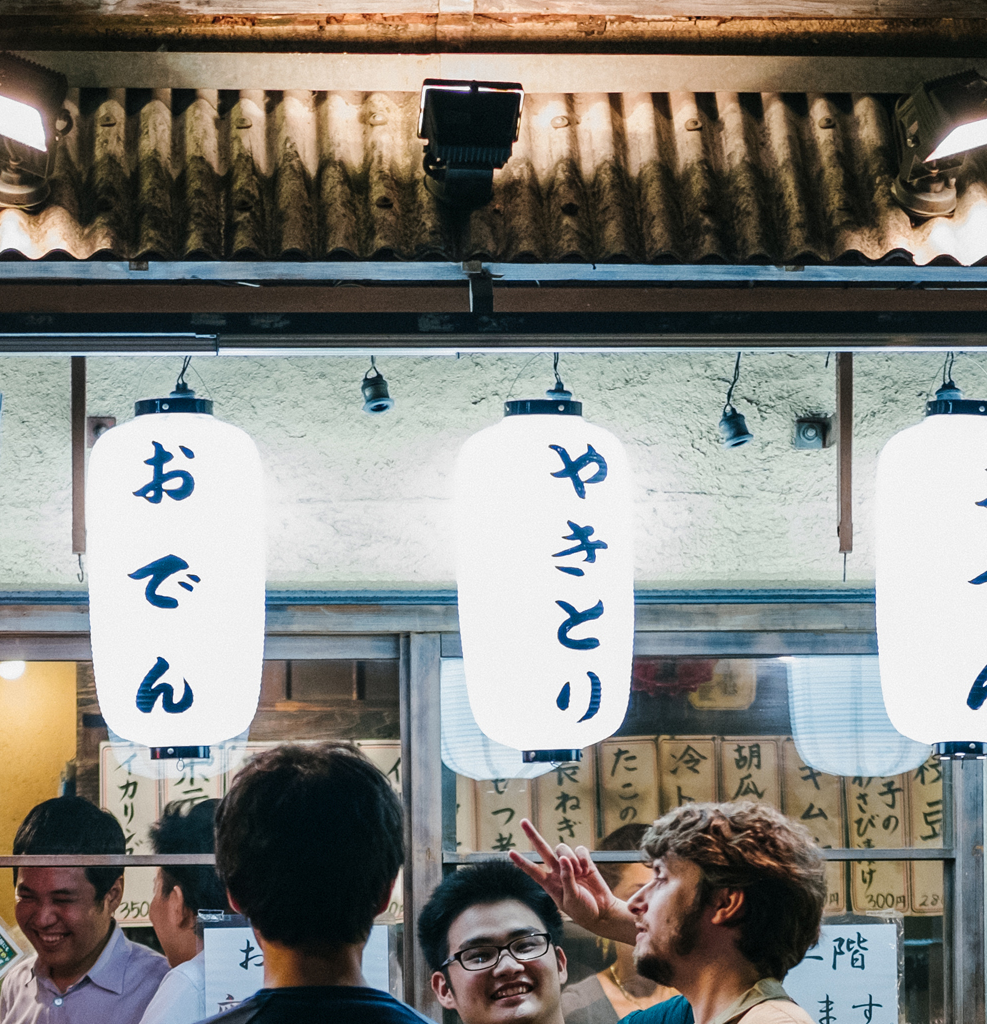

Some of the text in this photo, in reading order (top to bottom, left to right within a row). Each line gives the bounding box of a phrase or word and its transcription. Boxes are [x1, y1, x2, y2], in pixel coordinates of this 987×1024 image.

[127, 441, 201, 714] おでん
[549, 443, 608, 723] やきとり
[733, 743, 766, 800] 胡瓜
[866, 893, 906, 909] 300円
